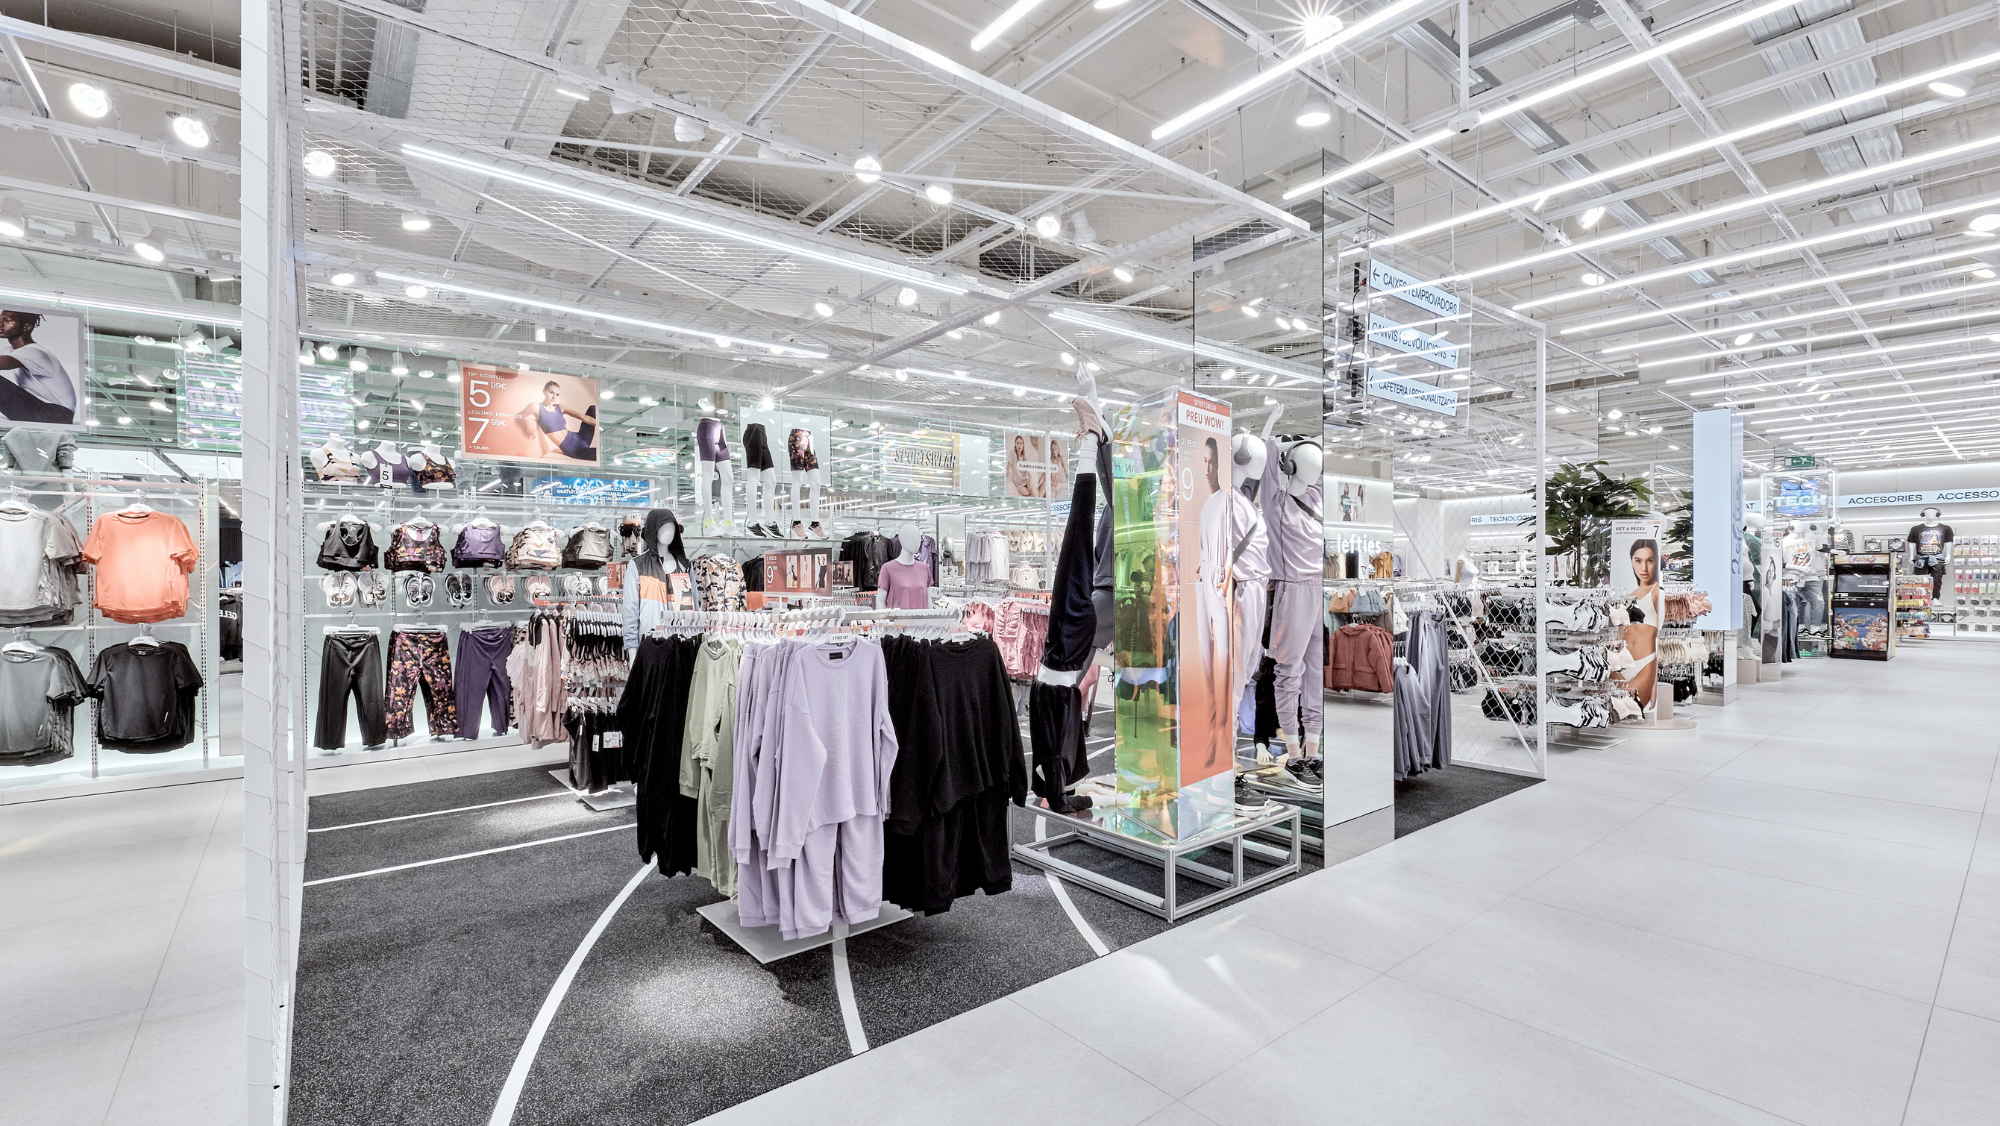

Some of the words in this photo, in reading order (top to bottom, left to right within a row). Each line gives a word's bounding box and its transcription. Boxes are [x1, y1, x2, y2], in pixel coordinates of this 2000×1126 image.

[1382, 272, 1407, 294] CAIXES
[1411, 287, 1458, 315] EMPROVADORS
[1371, 322, 1398, 342] CANVIS
[469, 379, 491, 408] 5
[1378, 380, 1408, 396] CAFETERIA
[467, 409, 493, 417] LEGGINGS
[1193, 398, 1217, 412] SPORTSWEAR
[1185, 409, 1203, 425] PREU
[1203, 413, 1225, 431] WOW!
[468, 416, 490, 444] 7
[1181, 438, 1186, 446] 2
[894, 448, 957, 469] SPORTSWEAR
[381, 470, 390, 481] 5
[1181, 466, 1194, 502] 9
[1773, 494, 1828, 507] TECH
[1848, 494, 1923, 505] ACCESORIES
[1936, 490, 2000, 501] ACCESSO
[1490, 514, 1535, 522] TECNOLOG
[1653, 525, 1660, 538] 7
[1337, 533, 1382, 554] lefties
[766, 565, 774, 584] 9
